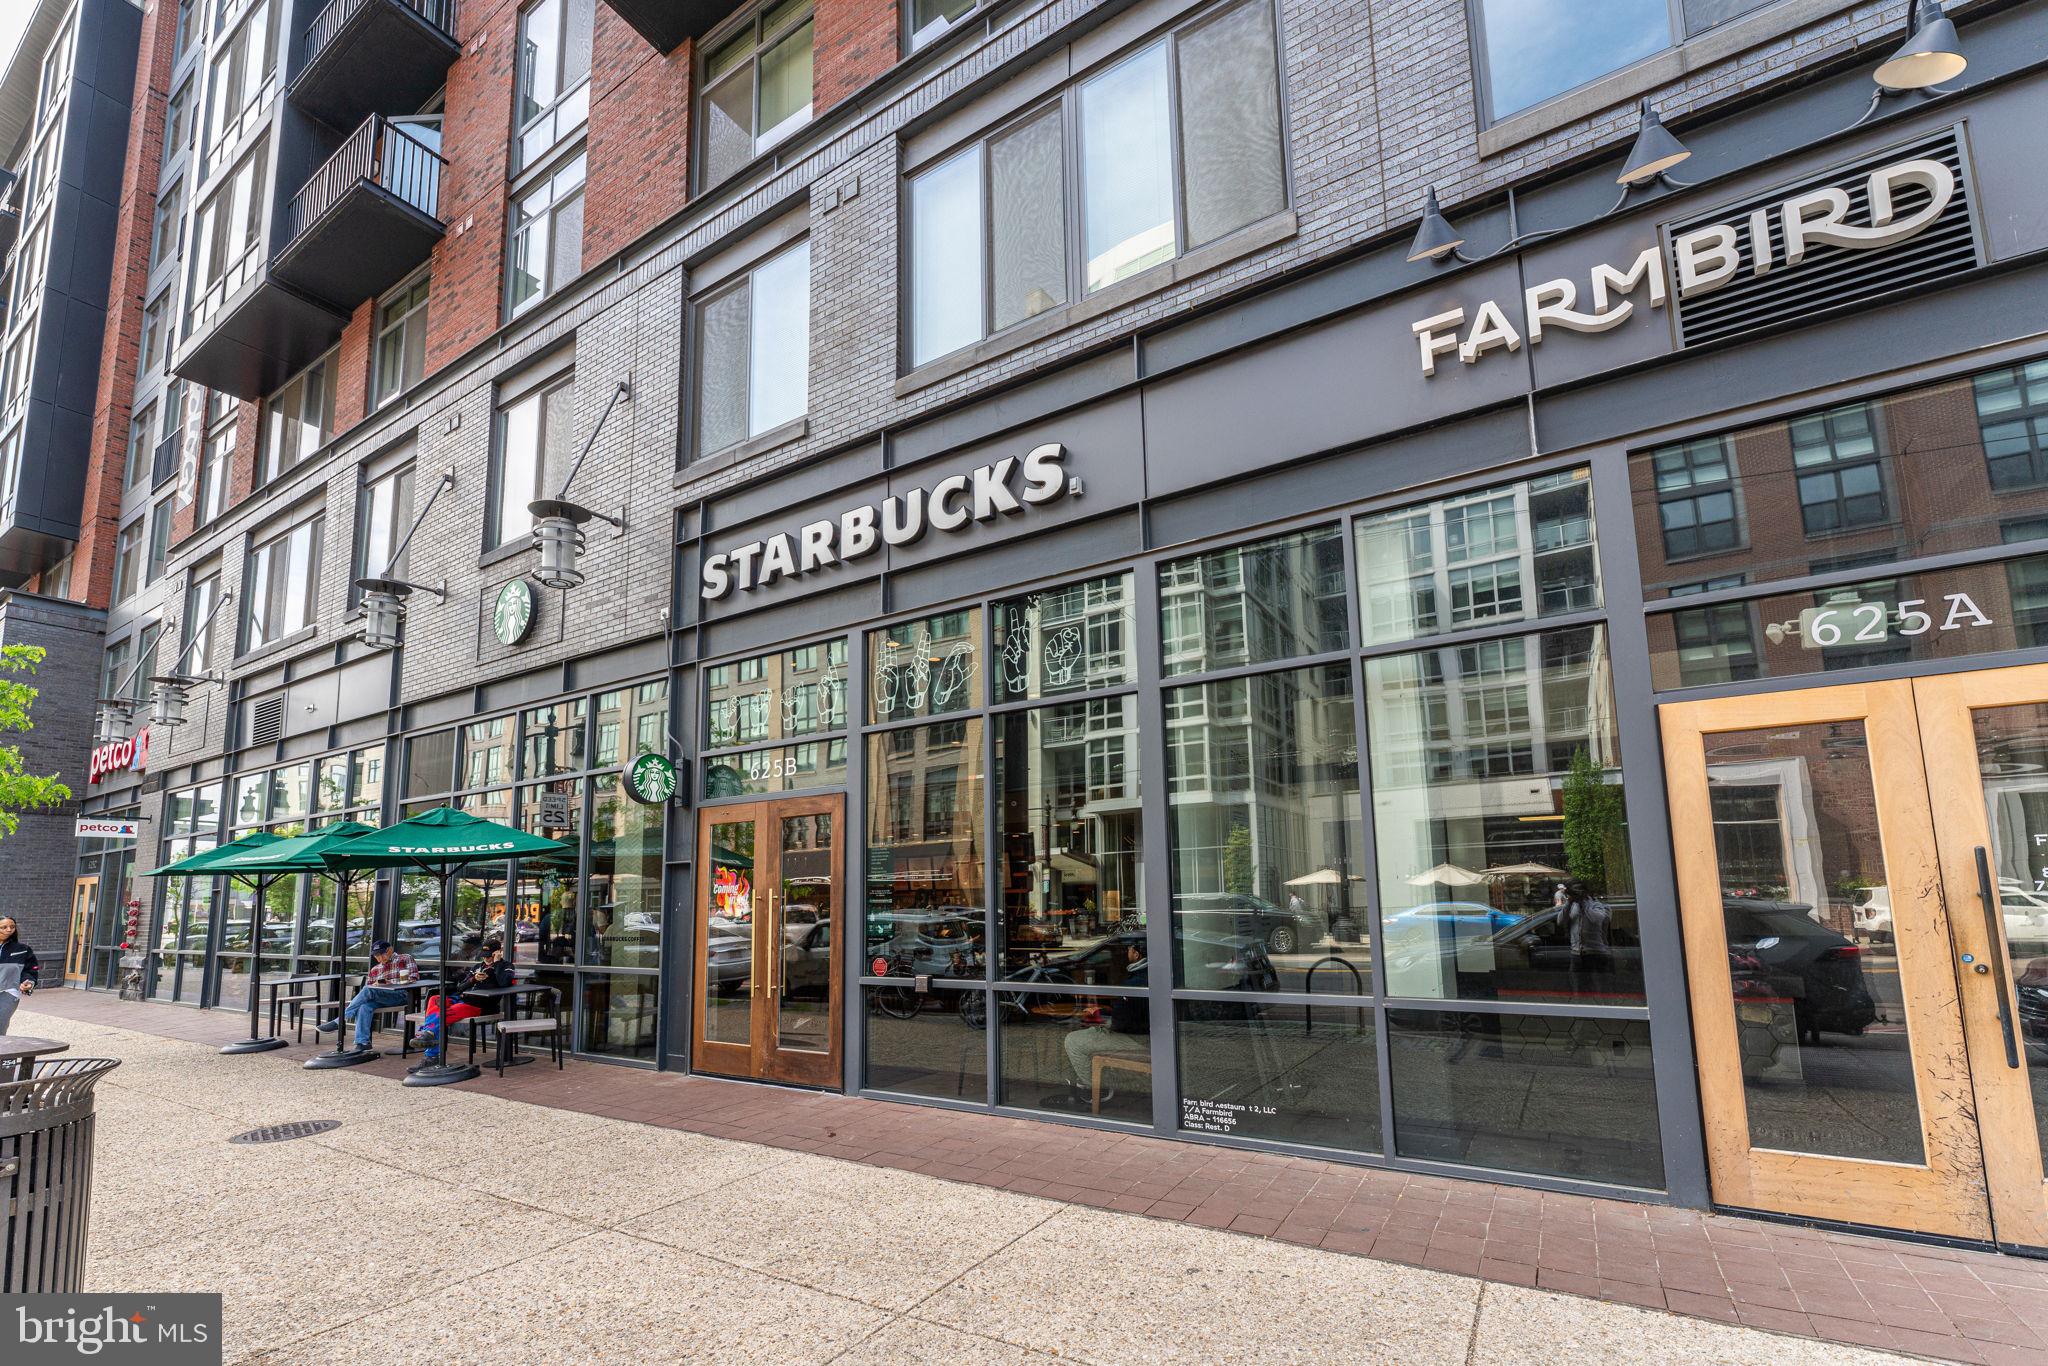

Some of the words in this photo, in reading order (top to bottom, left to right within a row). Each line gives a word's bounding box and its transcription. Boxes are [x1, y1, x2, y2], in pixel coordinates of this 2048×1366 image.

[1412, 158, 1956, 378] FARMBIRD
[701, 443, 1067, 601] STARBUCKS
[1809, 592, 1993, 647] 625A
[90, 740, 132, 784] petco
[750, 757, 797, 780] 625B
[80, 824, 118, 834] petco
[388, 841, 515, 853] STARBUCKS
[1183, 1105, 1200, 1113] T/A
[1202, 1108, 1233, 1117] Farmbird
[1215, 1103, 1253, 1112] estaurat
[1263, 1106, 1277, 1115] LLC
[1184, 1113, 1205, 1121] ABRA
[1184, 1121, 1204, 1129] Class:
[1205, 1123, 1223, 1131] Rest.
